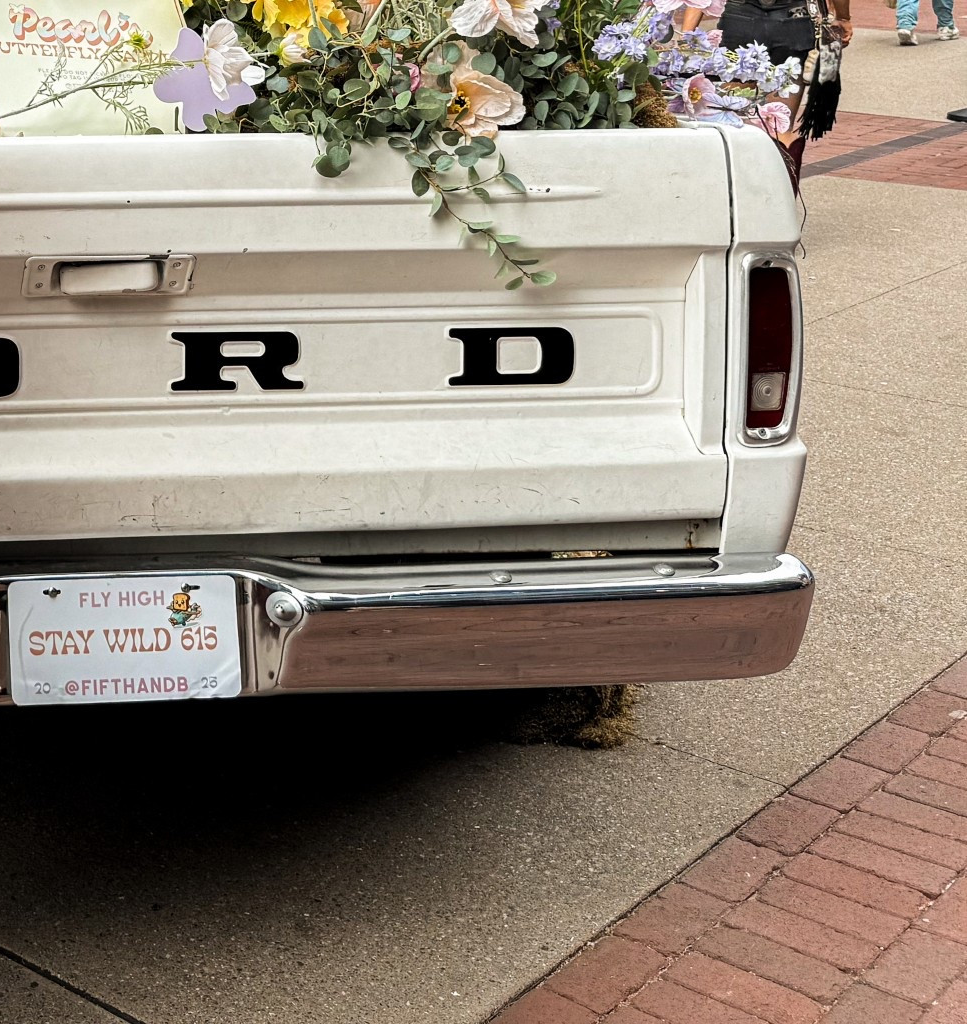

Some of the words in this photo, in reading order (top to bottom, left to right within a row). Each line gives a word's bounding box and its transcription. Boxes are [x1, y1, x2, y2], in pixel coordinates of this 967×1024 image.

[79, 591, 112, 608] FLY
[118, 590, 165, 607] HIGH
[29, 629, 95, 656] STAY
[103, 627, 172, 654] WILD
[180, 625, 218, 651] 615
[34, 682, 51, 695] 20
[64, 676, 189, 696] @FIFTHANDB
